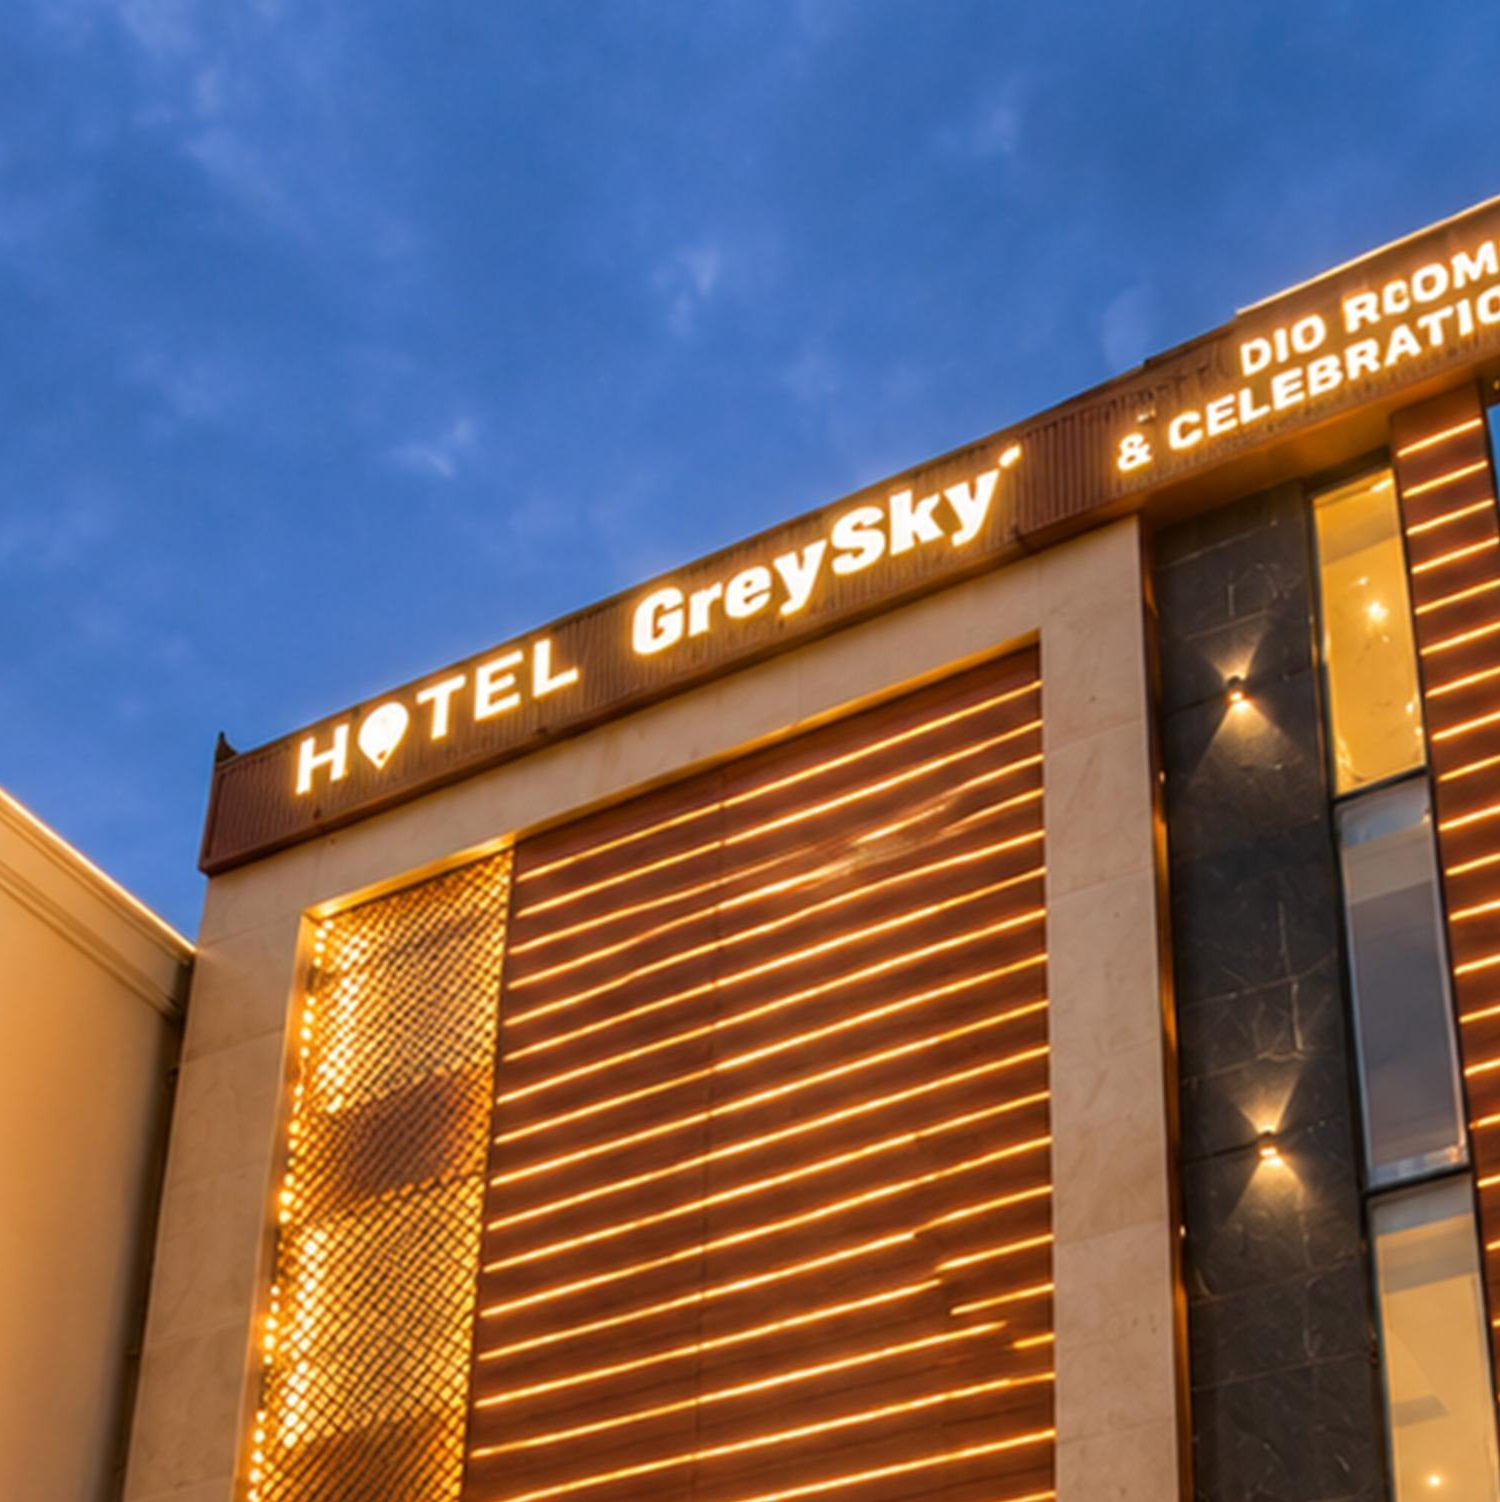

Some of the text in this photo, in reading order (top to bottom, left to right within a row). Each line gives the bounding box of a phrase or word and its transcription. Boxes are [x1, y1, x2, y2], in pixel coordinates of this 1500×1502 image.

[1115, 431, 1153, 473] &
[294, 445, 1022, 796] HOTEL GreySky
